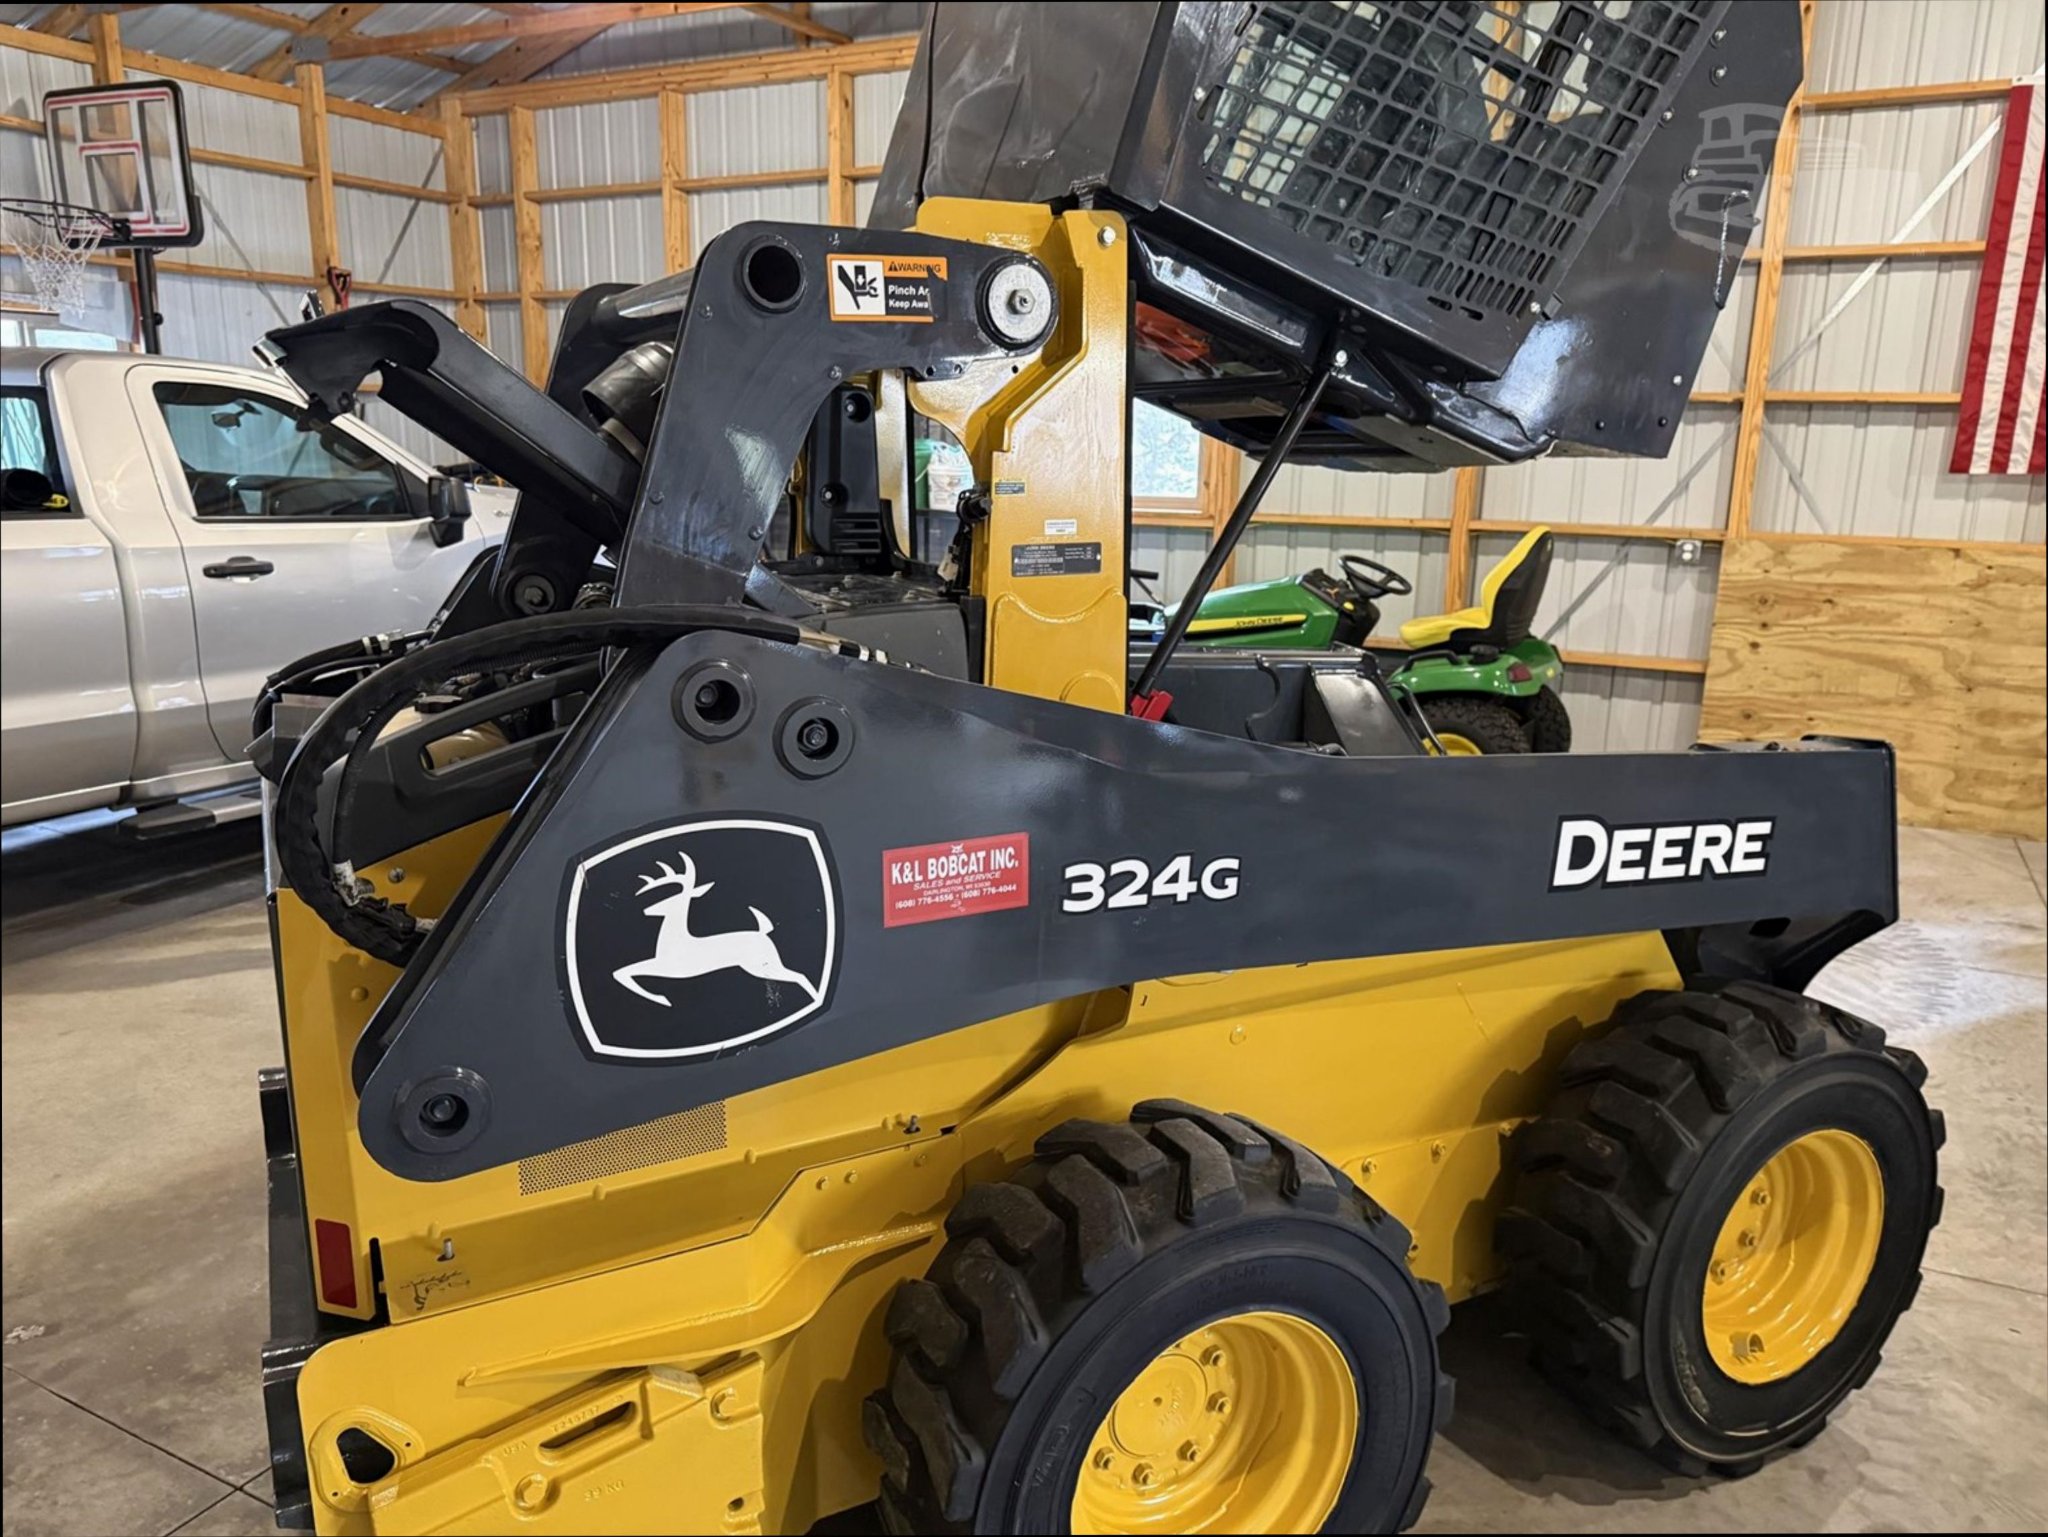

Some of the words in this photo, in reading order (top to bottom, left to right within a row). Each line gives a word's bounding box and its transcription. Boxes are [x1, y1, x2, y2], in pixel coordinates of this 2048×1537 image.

[888, 284, 916, 295] Pinch
[888, 299, 910, 310] Keep
[1256, 616, 1283, 625] DEERE
[1552, 820, 1772, 887] DEERE
[891, 861, 923, 885] K&L
[927, 850, 986, 879] BOBCAT
[990, 846, 1019, 868] INC.
[913, 879, 944, 891] SALES
[963, 871, 1001, 883] SERVICE
[1062, 855, 1240, 913] 324G
